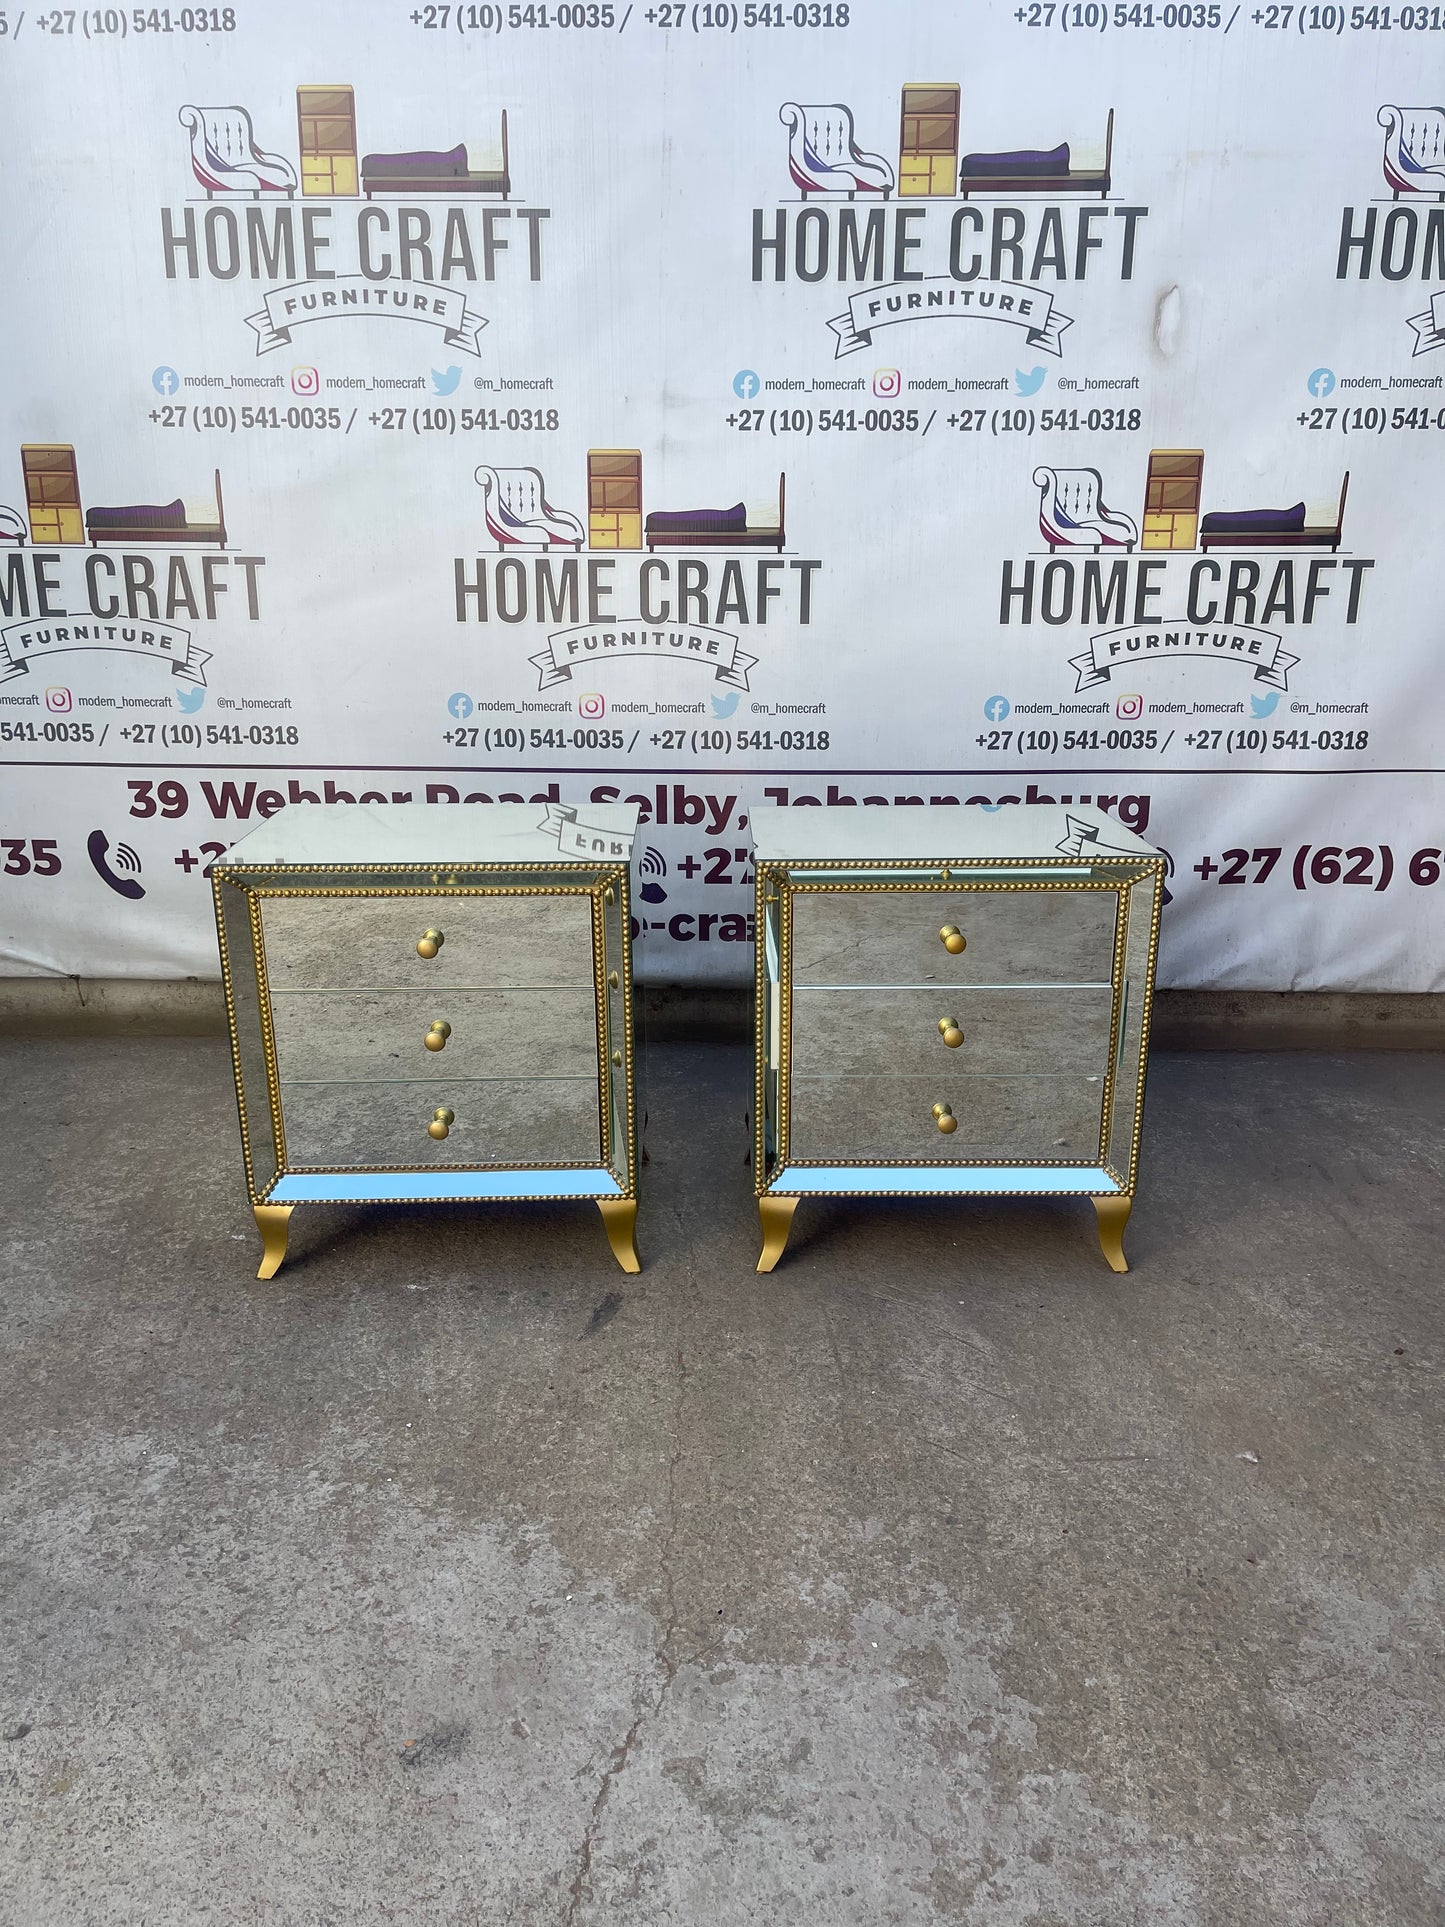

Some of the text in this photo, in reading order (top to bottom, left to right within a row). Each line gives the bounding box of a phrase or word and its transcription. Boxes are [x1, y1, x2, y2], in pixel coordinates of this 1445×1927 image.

[37, 10, 76, 34] +27
[83, 10, 127, 39] (10)
[133, 8, 236, 33] 541-0318
[410, 5, 450, 29] +27
[457, 5, 502, 34] (10)
[508, 4, 614, 28] 541-0035
[645, 4, 686, 27] +27
[692, 4, 737, 33] (10)
[744, 3, 849, 27] 541-0318
[1014, 3, 1056, 26] +27
[1062, 3, 1107, 32] (10)
[1114, 4, 1221, 28] 541-0035
[1251, 5, 1294, 28] +27
[1299, 6, 1344, 35] (10)
[1350, 6, 1445, 30] 541-031
[161, 207, 550, 281] HOME CRAFT
[752, 207, 1148, 281] HOME CRAFT
[285, 289, 447, 315] FURNITURE
[869, 290, 1033, 317] FURNITURE
[474, 377, 553, 391] @m_homecraft
[1058, 377, 1139, 392] @m_homecraft
[149, 406, 186, 427] +27
[193, 406, 236, 433] (10)
[242, 407, 341, 429] 541-0035
[369, 408, 406, 429] +27
[413, 409, 455, 435] (10)
[461, 409, 559, 430] 541-0318
[726, 410, 764, 431] +27
[770, 410, 813, 436] (10)
[818, 410, 918, 431] 541-0035
[947, 410, 986, 431] +27
[992, 410, 1035, 436] (10)
[1040, 409, 1141, 431] 541-0318
[1297, 408, 1337, 429] +27
[1342, 408, 1386, 434] (10)
[85, 554, 265, 620] CRAFT
[454, 558, 822, 624] HOME CRAFT
[1000, 560, 1375, 624] HOME CRAFT
[20, 627, 173, 649] FURNITURE
[567, 632, 720, 654] FURNITURE
[1109, 633, 1262, 656] FURNITURE
[217, 697, 292, 710] @m_homecraft
[751, 703, 826, 715] @m_homecraft
[1290, 702, 1368, 715] @m_homecraft
[1, 722, 94, 742] 541-0035
[120, 724, 155, 743] +27
[162, 725, 201, 748] (10)
[207, 725, 298, 745] 541-0318
[443, 728, 479, 747] +27
[485, 729, 525, 752] (10)
[530, 729, 623, 749] 541-0035
[650, 730, 686, 749] +27
[692, 731, 731, 754] (10)
[737, 731, 829, 750] 541-0318
[976, 731, 1013, 750] +27
[1018, 731, 1058, 754] (10)
[1063, 730, 1157, 749] 541-0035
[1185, 730, 1222, 749] +27
[1227, 730, 1267, 753] (10)
[1272, 730, 1368, 750] 541-0318
[127, 780, 189, 818] 39
[1194, 847, 1282, 885] +27
[1293, 844, 1394, 892] (62)
